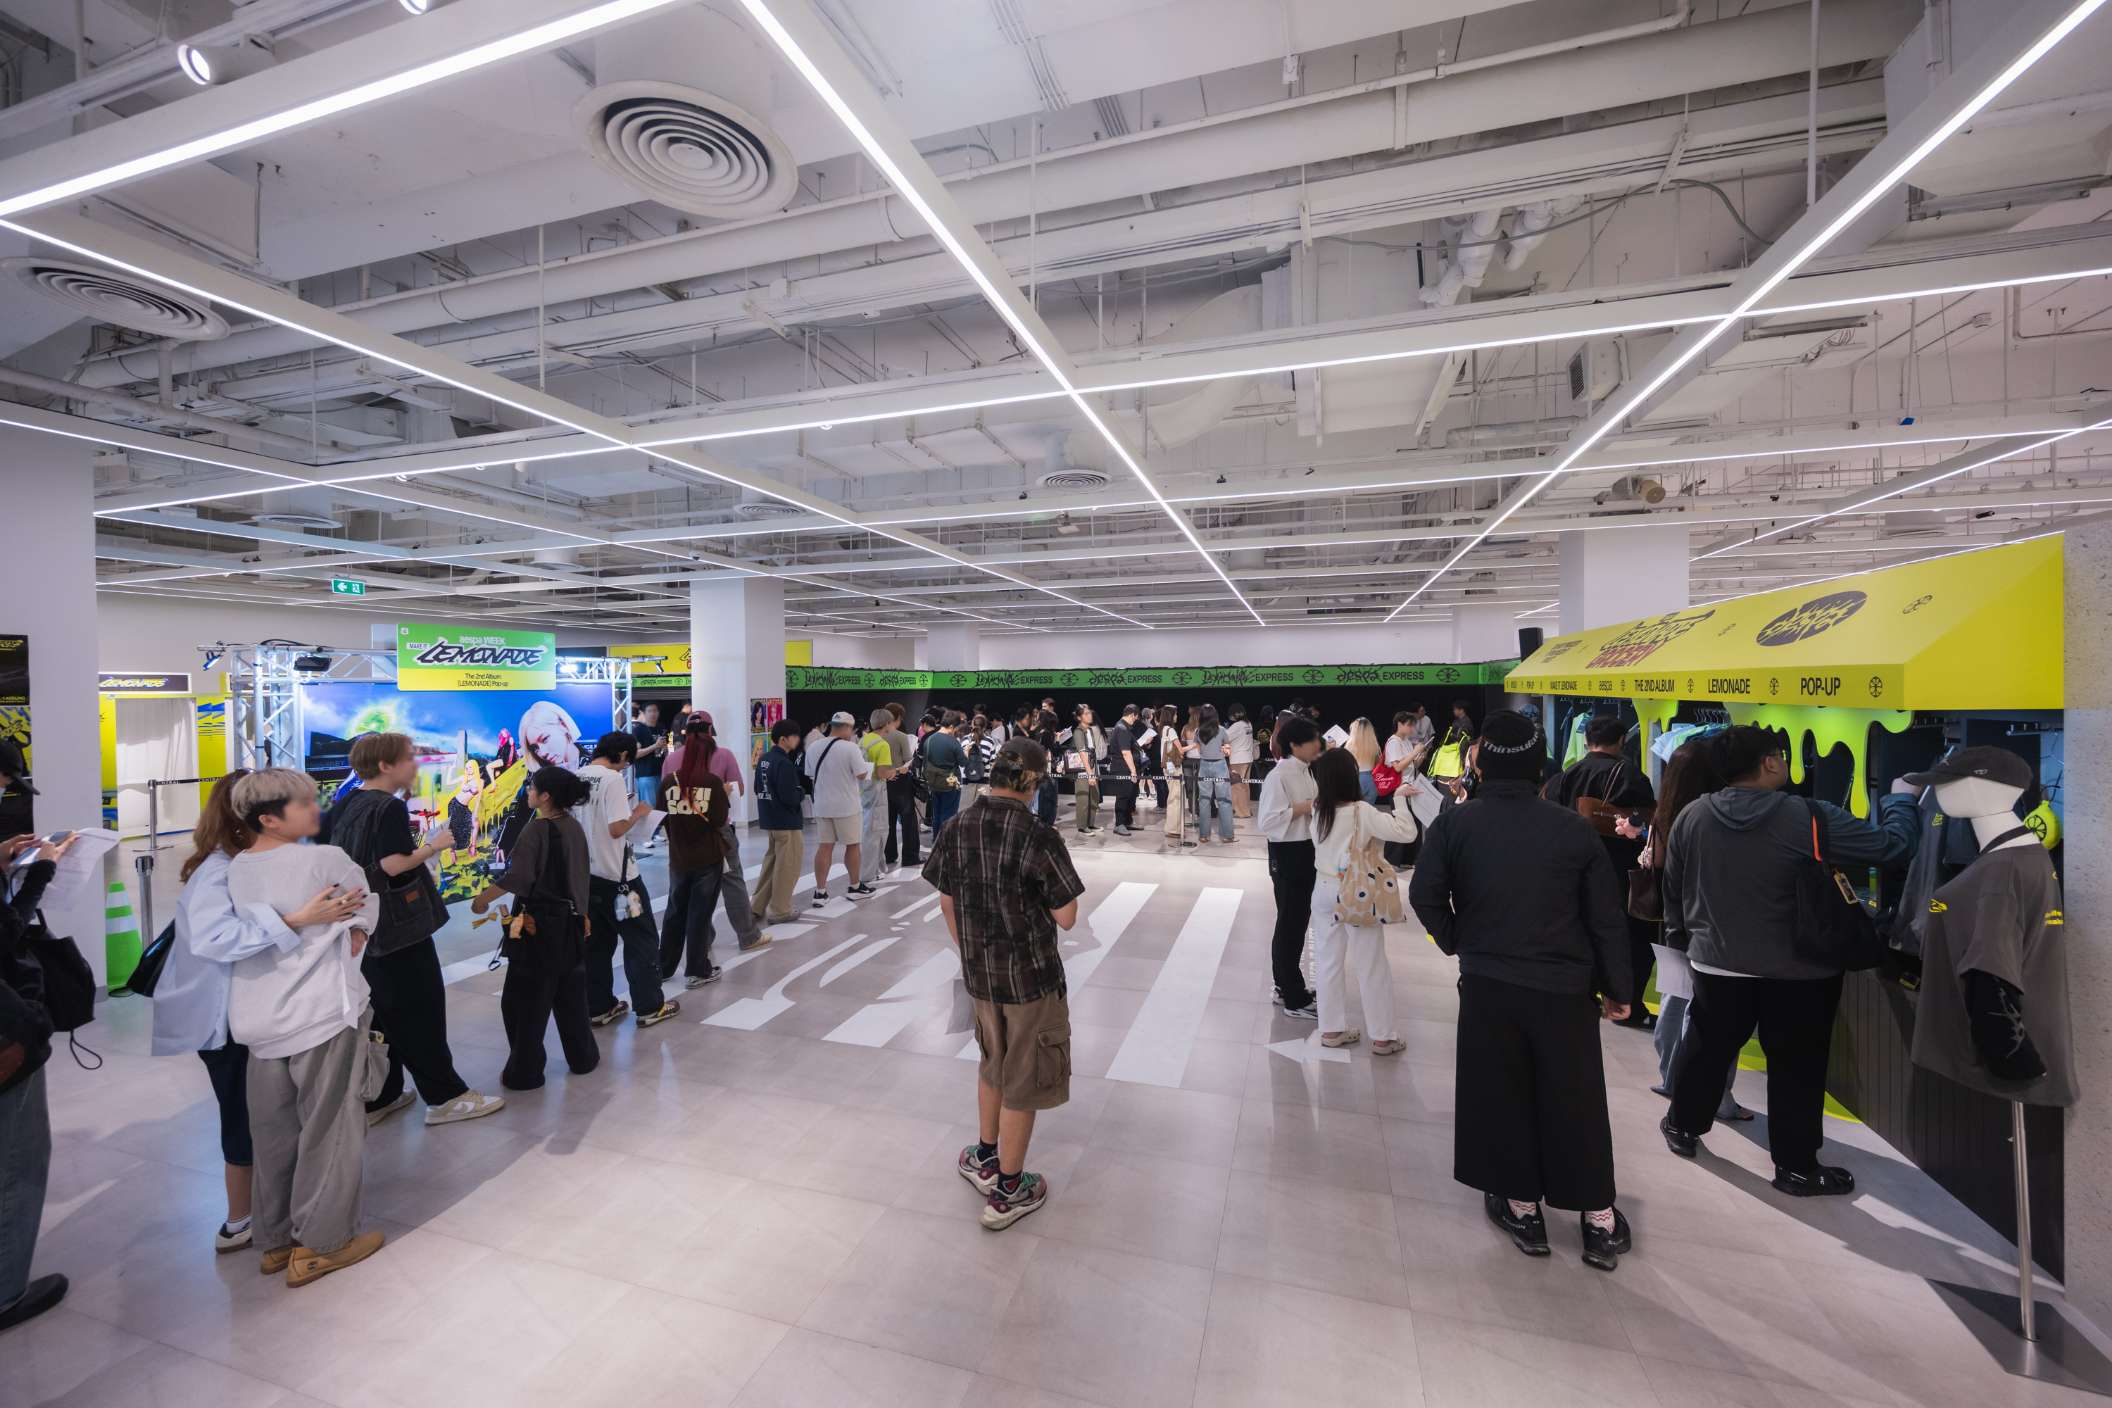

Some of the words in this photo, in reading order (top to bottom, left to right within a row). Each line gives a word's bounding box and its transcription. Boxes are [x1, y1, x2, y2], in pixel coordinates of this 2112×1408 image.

[415, 638, 545, 665] LEMONADE
[1020, 675, 1053, 685] EXPRESS
[1127, 674, 1162, 684] EXPRESS
[1255, 673, 1294, 682] EXPRESS
[1382, 671, 1425, 681] EXPRESS
[1634, 680, 1644, 692] THE
[1644, 680, 1655, 692] 2ND
[1655, 680, 1675, 692] ALBUM
[1708, 678, 1751, 694] LEMONADE
[1800, 677, 1841, 696] POP-UP
